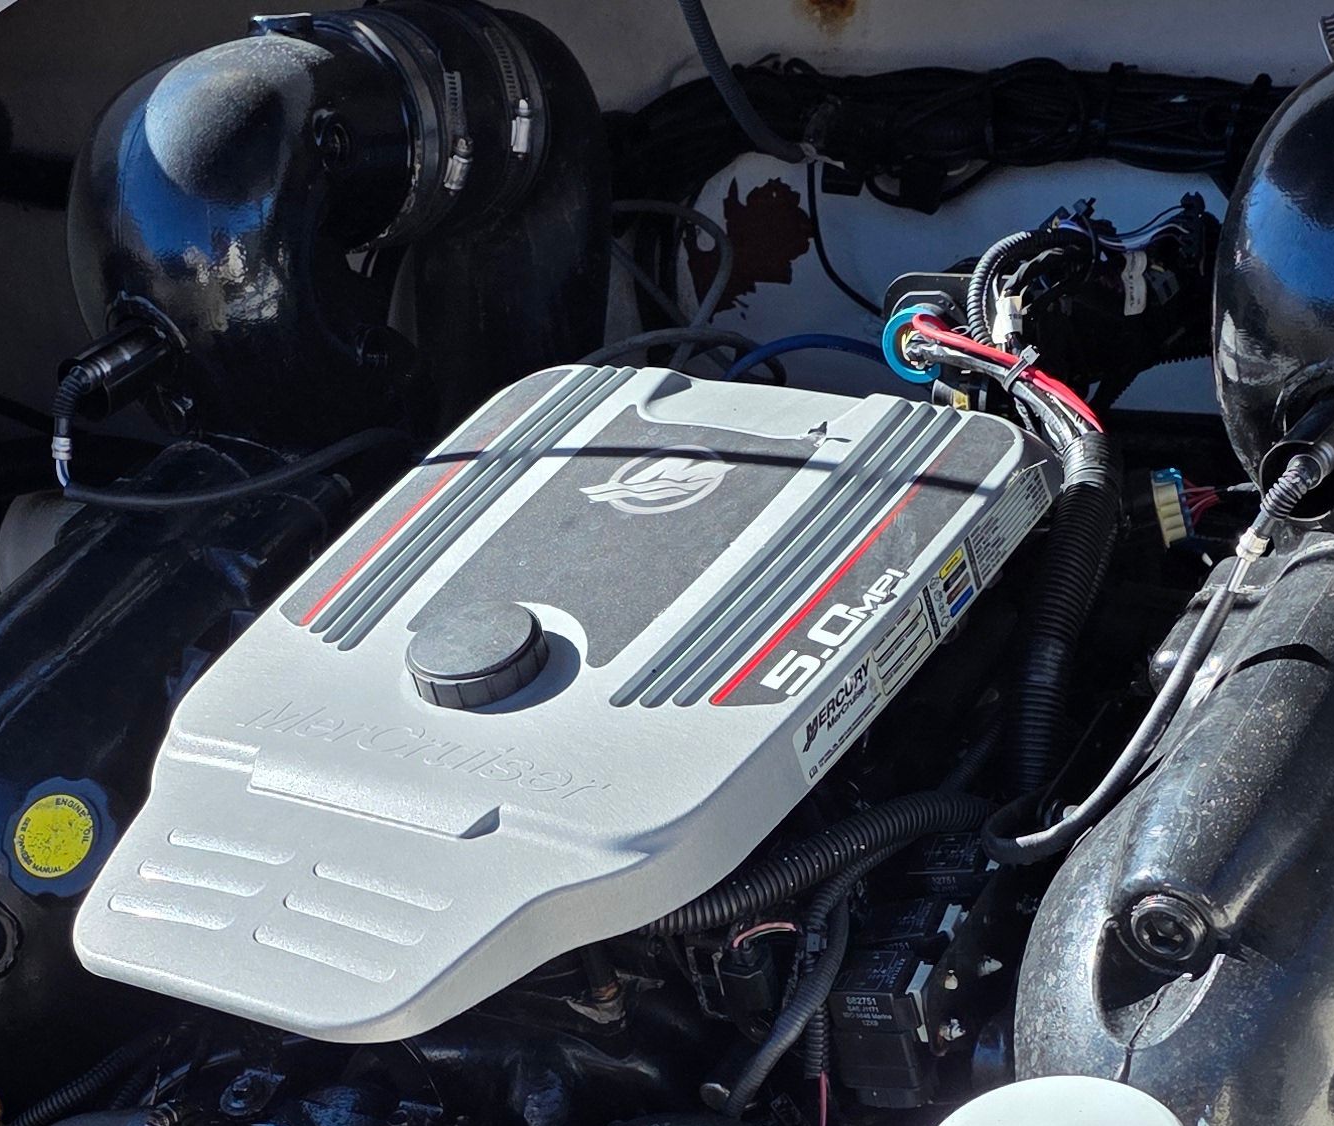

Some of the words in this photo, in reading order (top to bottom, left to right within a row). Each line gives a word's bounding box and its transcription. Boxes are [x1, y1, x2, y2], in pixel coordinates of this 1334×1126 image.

[760, 602, 861, 696] 5.0
[849, 568, 907, 622] MPI
[235, 700, 612, 800] MerCruiser
[803, 656, 871, 754] MERCURY
[32, 863, 63, 874] MANUAL
[54, 797, 88, 818] ENGINE
[81, 828, 91, 845] OIL
